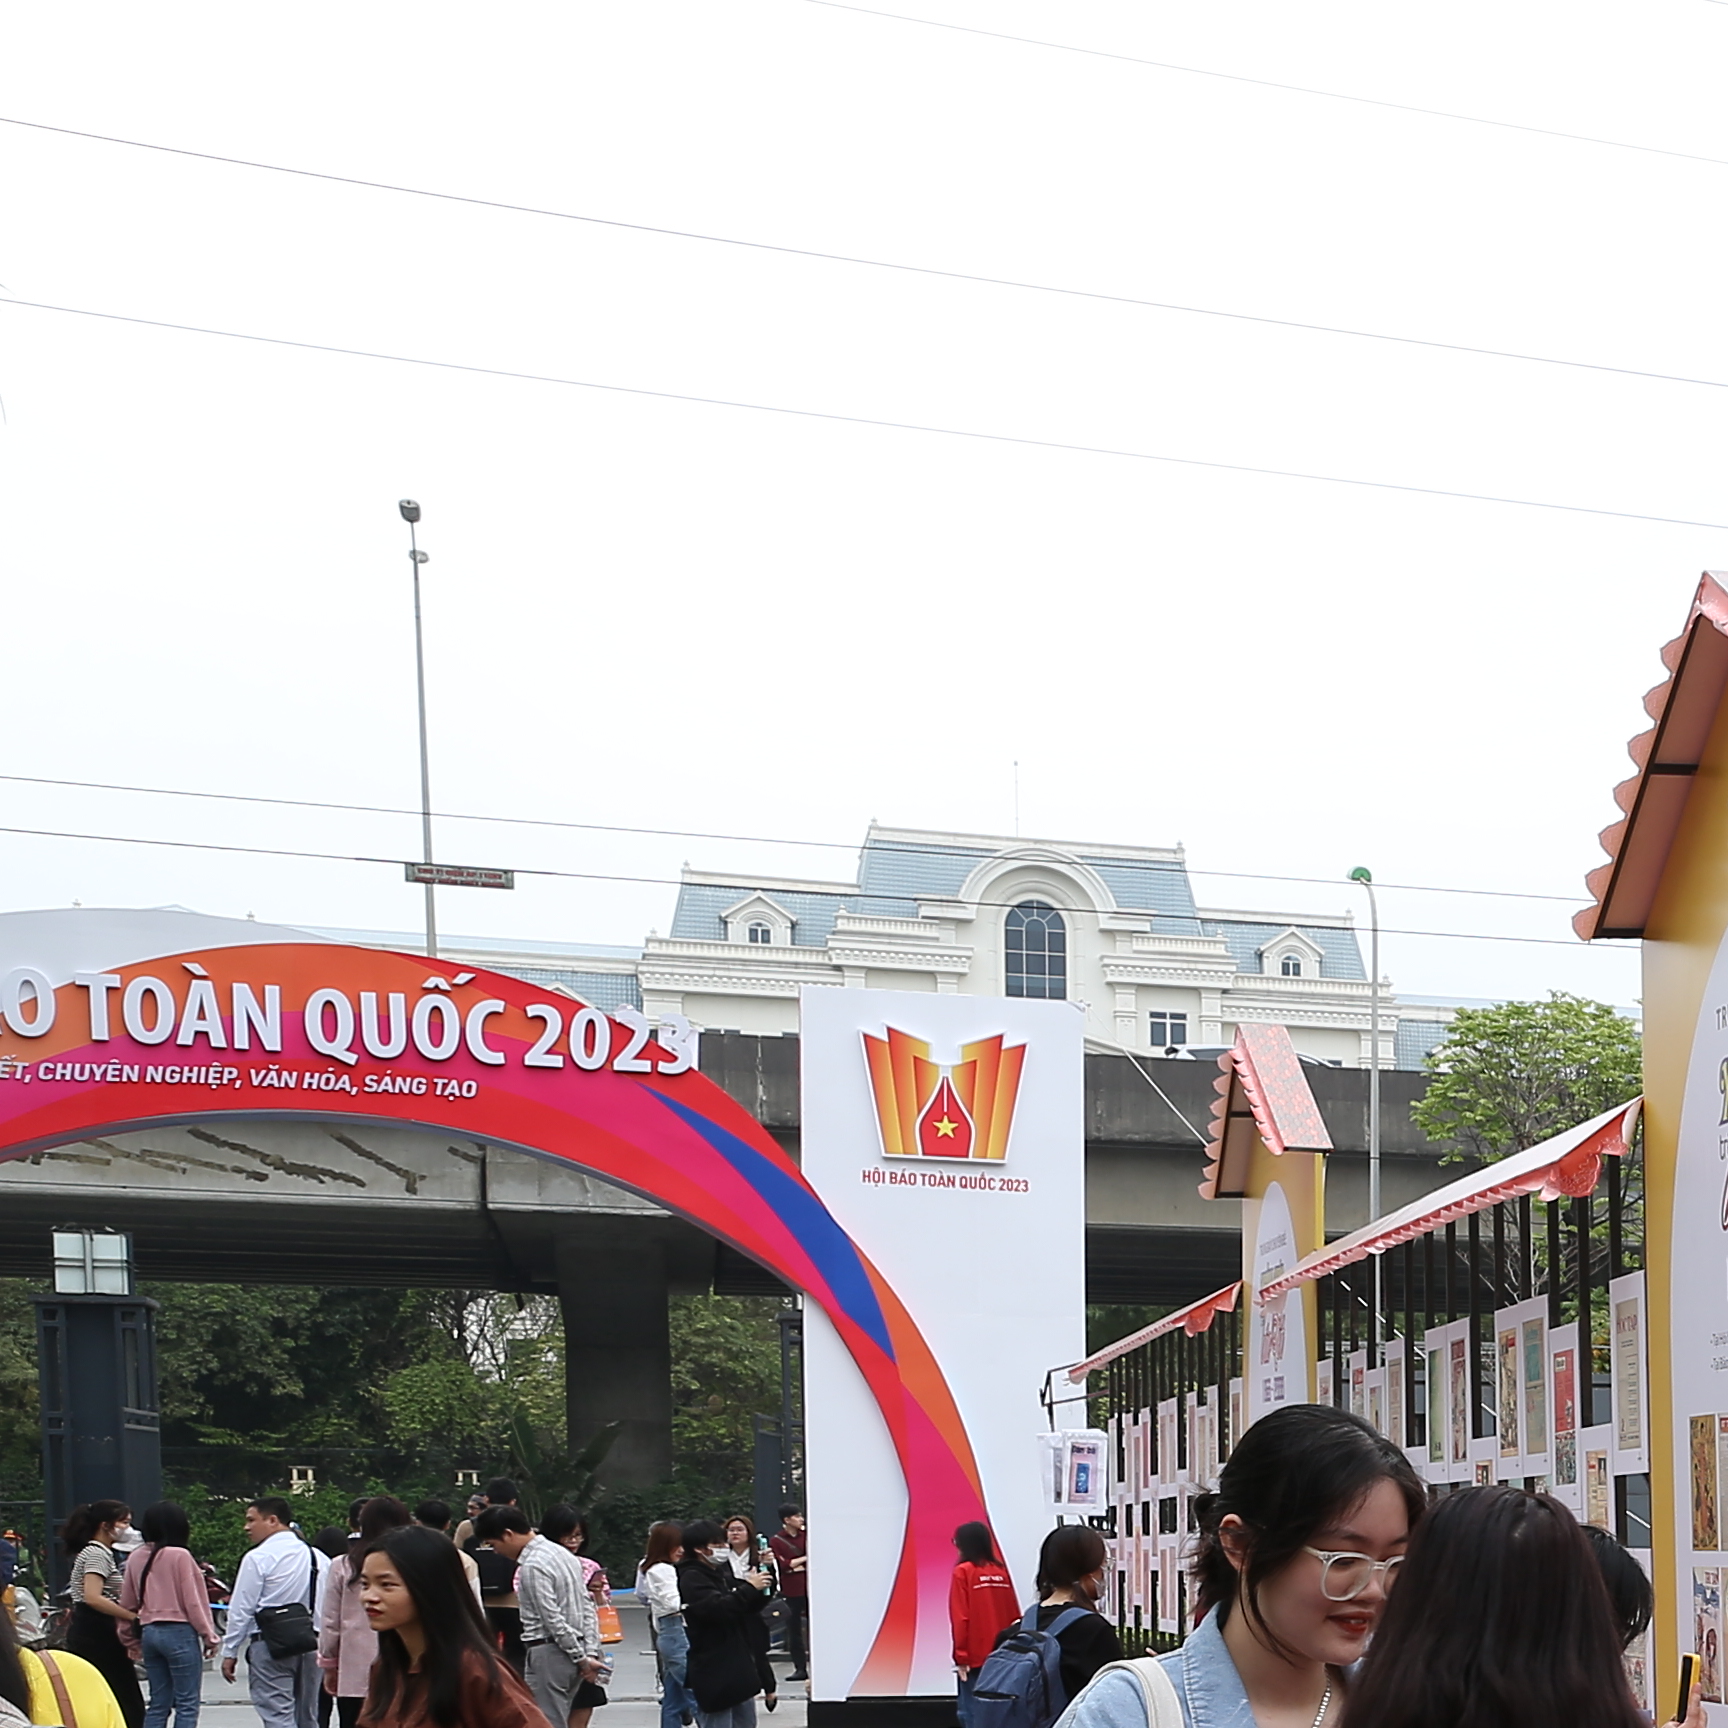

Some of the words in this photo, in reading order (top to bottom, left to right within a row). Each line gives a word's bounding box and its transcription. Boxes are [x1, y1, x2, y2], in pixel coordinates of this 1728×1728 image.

[0, 966, 56, 1038] O
[74, 962, 283, 1054] TOÀN
[304, 972, 507, 1067] QUỐC
[522, 1002, 694, 1075] 2023
[0, 1054, 32, 1084] ẾT,
[37, 1058, 142, 1084] CHUYÊN
[144, 1060, 243, 1090] NGHIỆP,
[248, 1066, 301, 1091] VĂN
[363, 1070, 428, 1096] SÁNG
[433, 1078, 479, 1101] TẠO
[862, 1166, 886, 1188] HỘI
[889, 1168, 917, 1186] BÁO
[920, 1170, 956, 1189] TOÀN
[959, 1171, 996, 1191] QUỐC
[998, 1178, 1030, 1193] 2023
